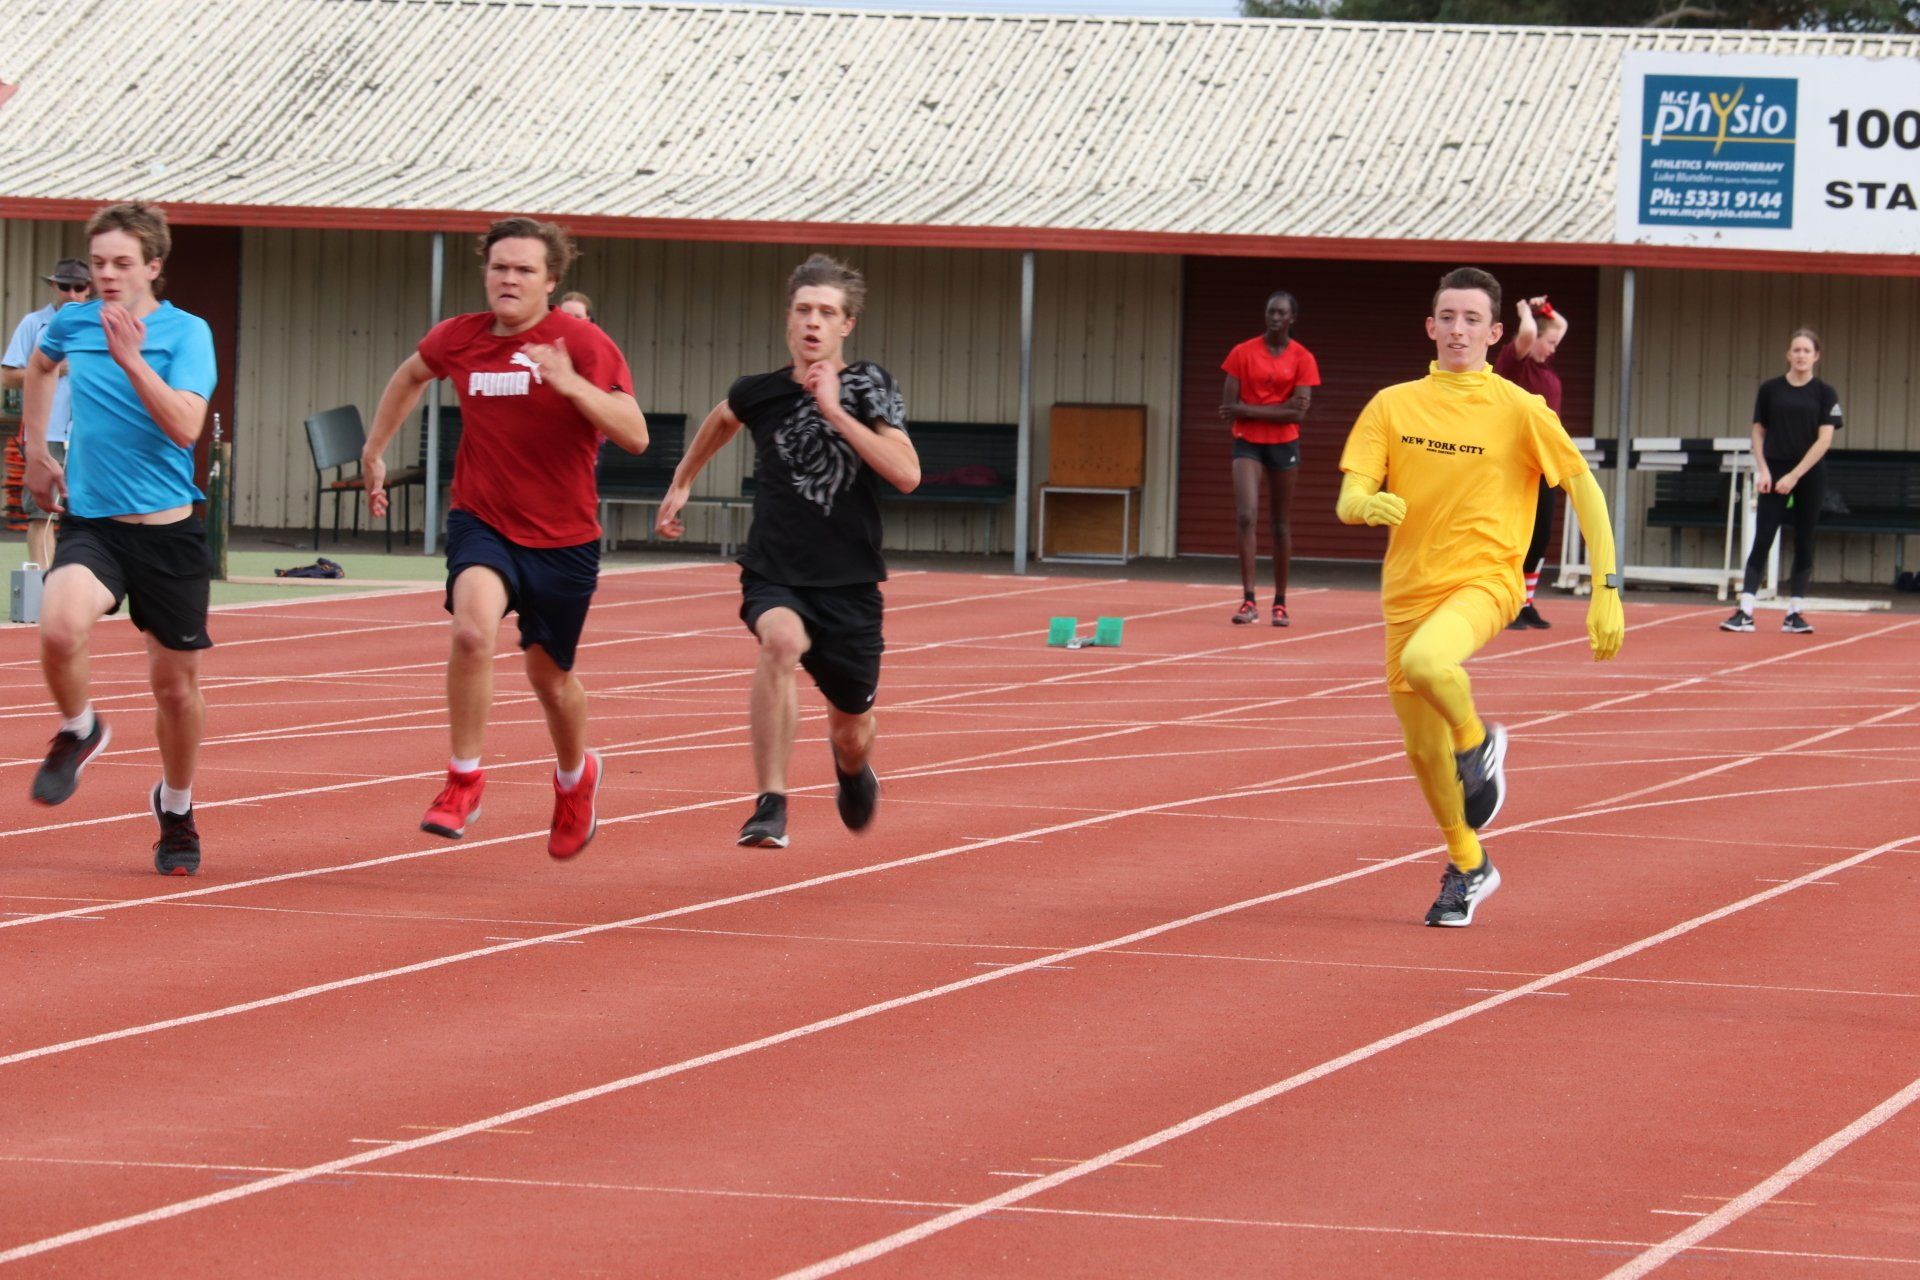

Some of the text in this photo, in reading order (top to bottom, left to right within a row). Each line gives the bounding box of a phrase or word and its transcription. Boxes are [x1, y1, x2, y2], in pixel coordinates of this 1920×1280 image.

[1660, 90, 1690, 105] M.C.
[1829, 108, 1920, 149] 100
[1651, 159, 1784, 173] ATHLETICS PHYSIOTHERAPY
[1650, 187, 1783, 209] Ph: 5331 9144
[1824, 180, 1918, 210] STA
[1649, 206, 1781, 221] www.mcphysio.com.au
[468, 371, 530, 396] PUMA
[1401, 435, 1426, 446] NEW
[1427, 439, 1458, 452] YORK
[1459, 444, 1486, 455] CITY
